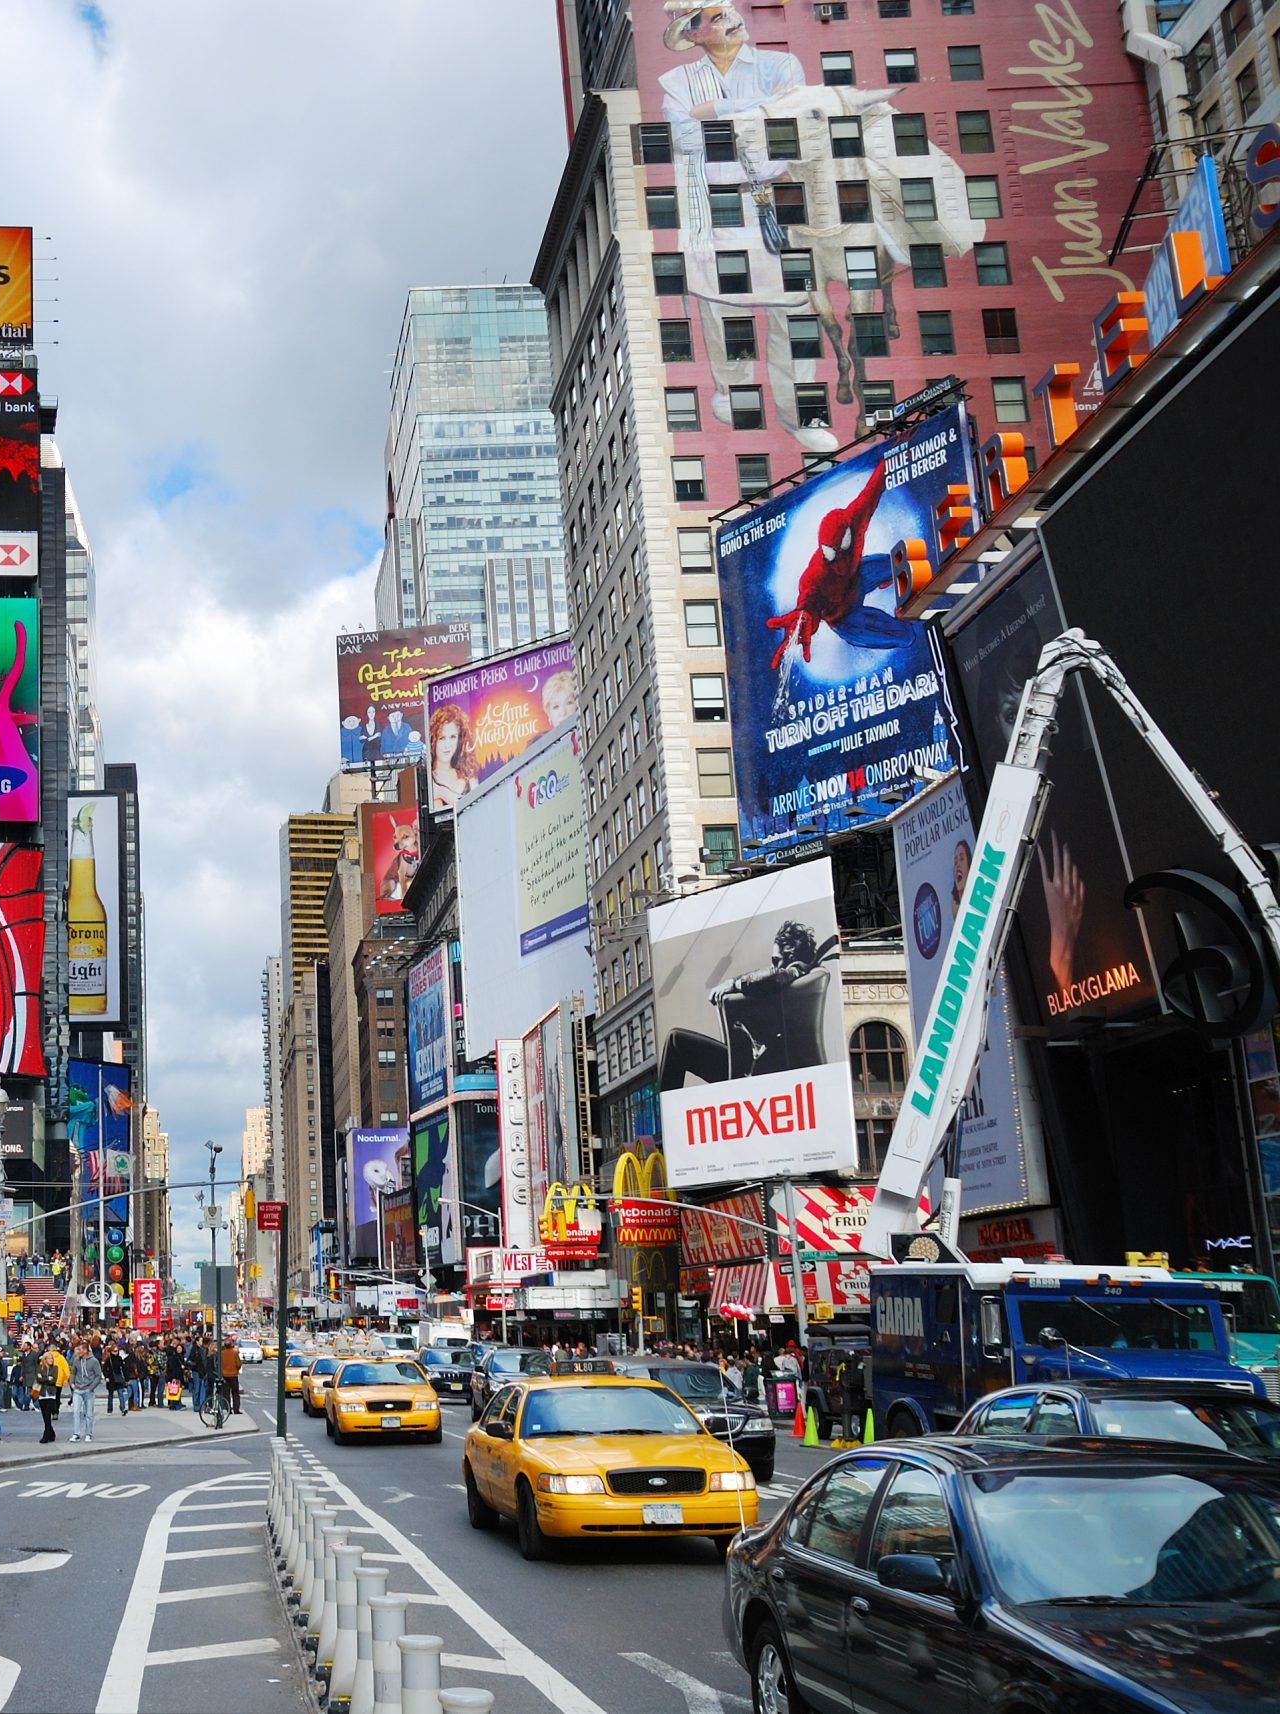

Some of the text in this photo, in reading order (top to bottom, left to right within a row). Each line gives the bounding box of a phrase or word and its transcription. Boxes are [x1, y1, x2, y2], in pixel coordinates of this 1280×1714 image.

[1032, 177, 1138, 303] Juan
[4, 402, 35, 413] bank
[884, 427, 957, 476] JULIE TAYMOR &
[885, 448, 947, 491] GLEN BERGER
[721, 512, 786, 558] BONO & THE EDGE
[337, 632, 470, 646] NATHAN NEUWIRTH
[449, 622, 469, 634] BEBE
[338, 644, 363, 656] LANE
[382, 646, 426, 663] The
[433, 665, 508, 703] BERNADETTE PETERS
[788, 666, 894, 720] SPIDER-MAN
[765, 670, 941, 754] TURN OFF THE DARK
[839, 718, 901, 754] JULIE TAYMOR
[772, 739, 950, 817] ARRIVES NOV 14 ON BROADWAY
[917, 792, 955, 829] WORLD'S
[904, 822, 942, 861] POPULAR
[911, 842, 1006, 1117] LANDMARK
[1045, 960, 1141, 1017] BLACKGLAMA
[507, 1053, 527, 1206] PALACE
[685, 1081, 817, 1146] maxell
[357, 1134, 402, 1143] Nocturnal.
[1205, 1234, 1252, 1251] MAC
[502, 1252, 532, 1271] WEST
[140, 1282, 157, 1316] tkts
[1029, 1278, 1061, 1289] GARDA
[1104, 1287, 1123, 1296] 540
[875, 1296, 924, 1338] GARDA
[573, 1362, 593, 1373] 3L80
